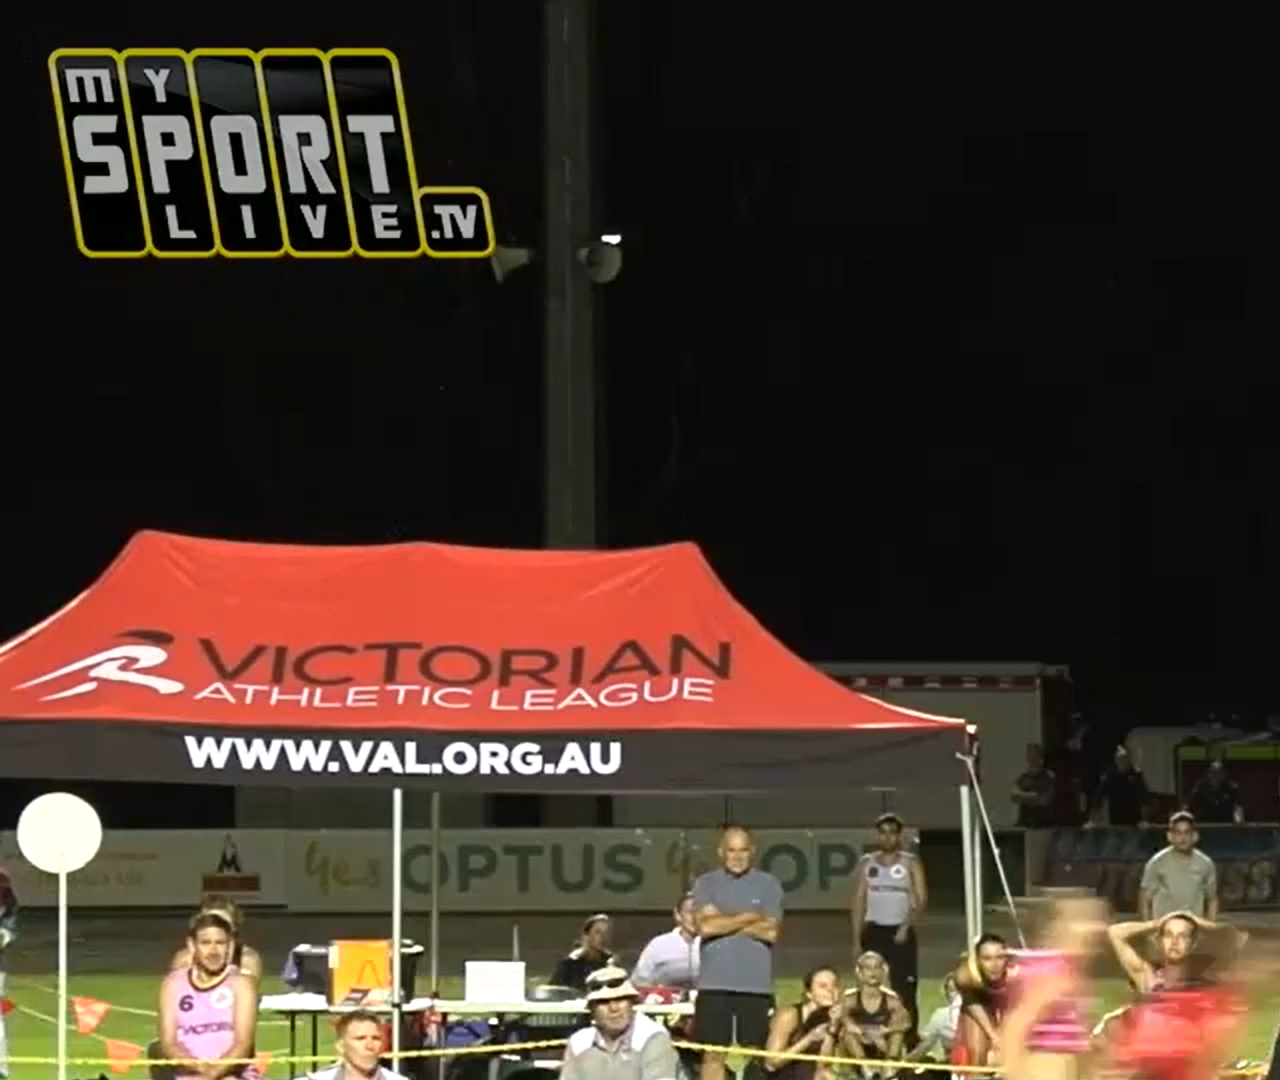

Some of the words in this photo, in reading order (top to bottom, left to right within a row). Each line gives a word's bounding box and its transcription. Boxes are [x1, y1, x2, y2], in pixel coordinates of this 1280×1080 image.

[198, 633, 732, 687] VICTORIAN
[193, 682, 471, 709] ATHLETIC
[490, 677, 716, 711] LEAGUE
[184, 735, 622, 775] WWW.VAL.ORG.AU
[401, 843, 644, 894] OPTUS
[179, 995, 194, 1012] 6
